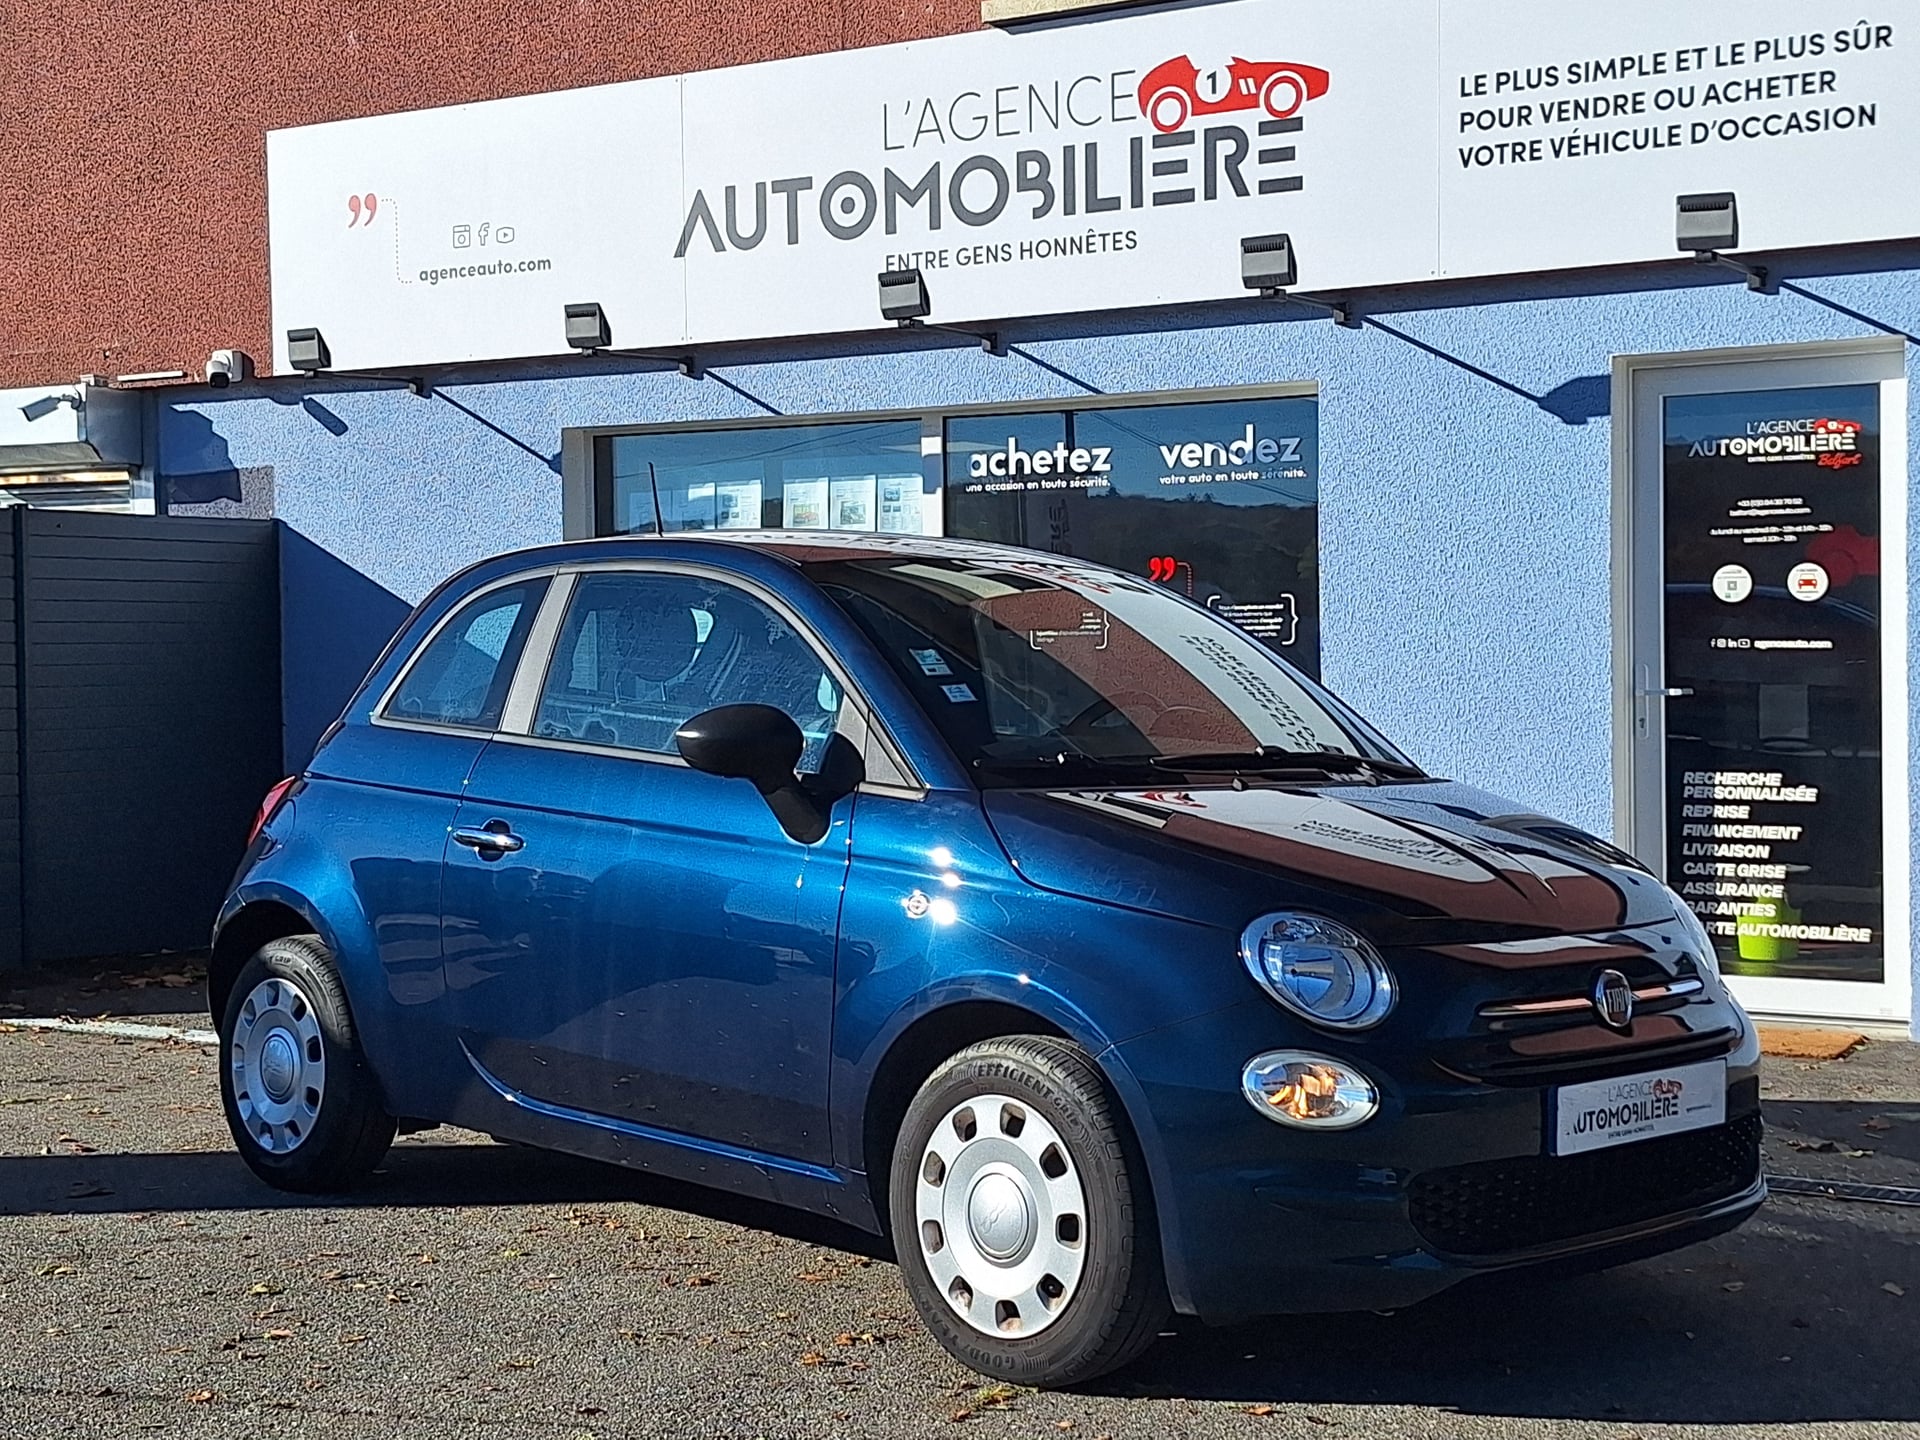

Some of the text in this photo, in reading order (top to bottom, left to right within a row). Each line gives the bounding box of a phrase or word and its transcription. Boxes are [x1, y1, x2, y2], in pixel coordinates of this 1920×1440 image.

[1460, 20, 1893, 98] LE PLUS SIMPLE ET LE PLUS SÛR
[883, 70, 1138, 151] L'AGENCE
[1460, 70, 1837, 134] POUR VENDRE OU ACHETER
[1459, 103, 1877, 168] VOTRE VÉHICULE D'OCCASION
[886, 228, 1138, 272] ENTRE GENS HONNÊTES
[419, 259, 552, 285] agenceauto.com
[1747, 419, 1815, 435] L'AGENCE
[1160, 424, 1300, 469] vendez
[967, 437, 1111, 478] achetez
[1027, 482, 1039, 490] en
[1041, 479, 1067, 489] toute
[1160, 474, 1186, 485] votre
[1189, 472, 1212, 483] auto
[1215, 473, 1228, 482] en
[1231, 470, 1259, 481] toute
[1683, 772, 1782, 786] RECHERCHE
[1683, 785, 1818, 802] PERSONNALISÉE
[1682, 804, 1750, 819] REPRISE
[1682, 824, 1802, 840] FINANCEMENT
[1682, 843, 1770, 859] LIVRAISON
[1683, 862, 1787, 879] CARTE GRISE
[1682, 882, 1784, 898] ASSURANCE
[1737, 922, 1872, 943] AUTOMOBILIÈRE
[977, 1062, 1056, 1099] EFFICIENT
